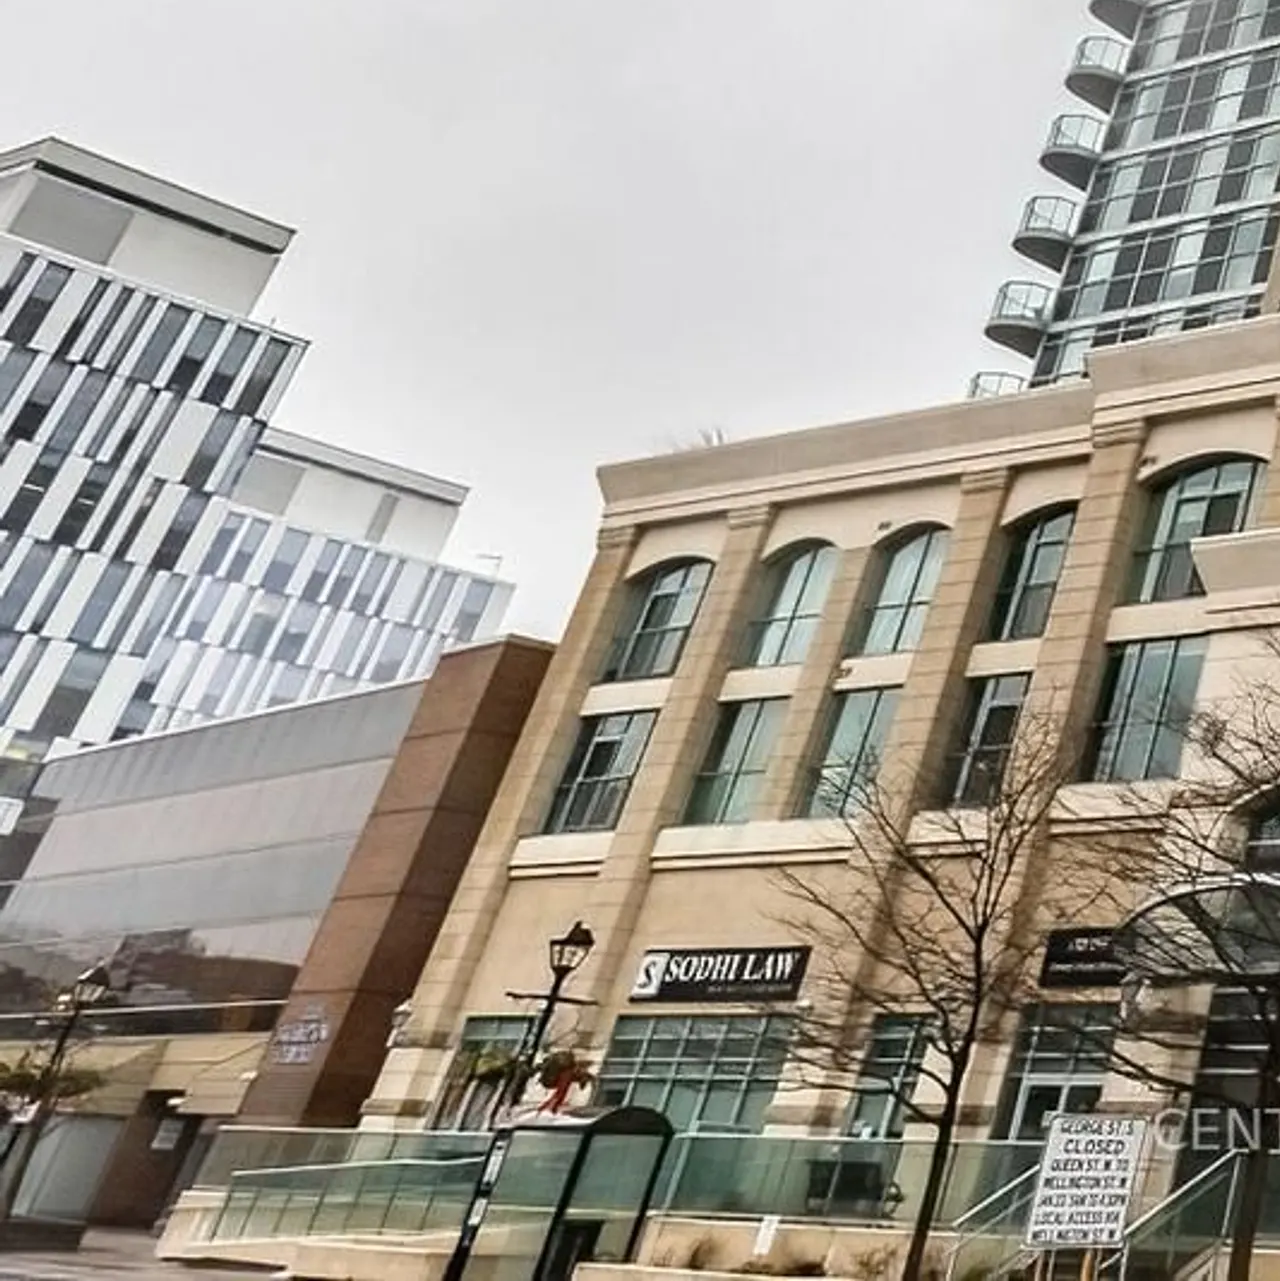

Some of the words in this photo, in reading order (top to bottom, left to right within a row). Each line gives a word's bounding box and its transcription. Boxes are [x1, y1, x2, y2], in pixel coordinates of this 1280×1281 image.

[664, 953, 741, 982] SODHI
[741, 951, 801, 981] LAW
[1063, 1139, 1125, 1155] CLOSED
[1051, 1159, 1084, 1172] QUEEN
